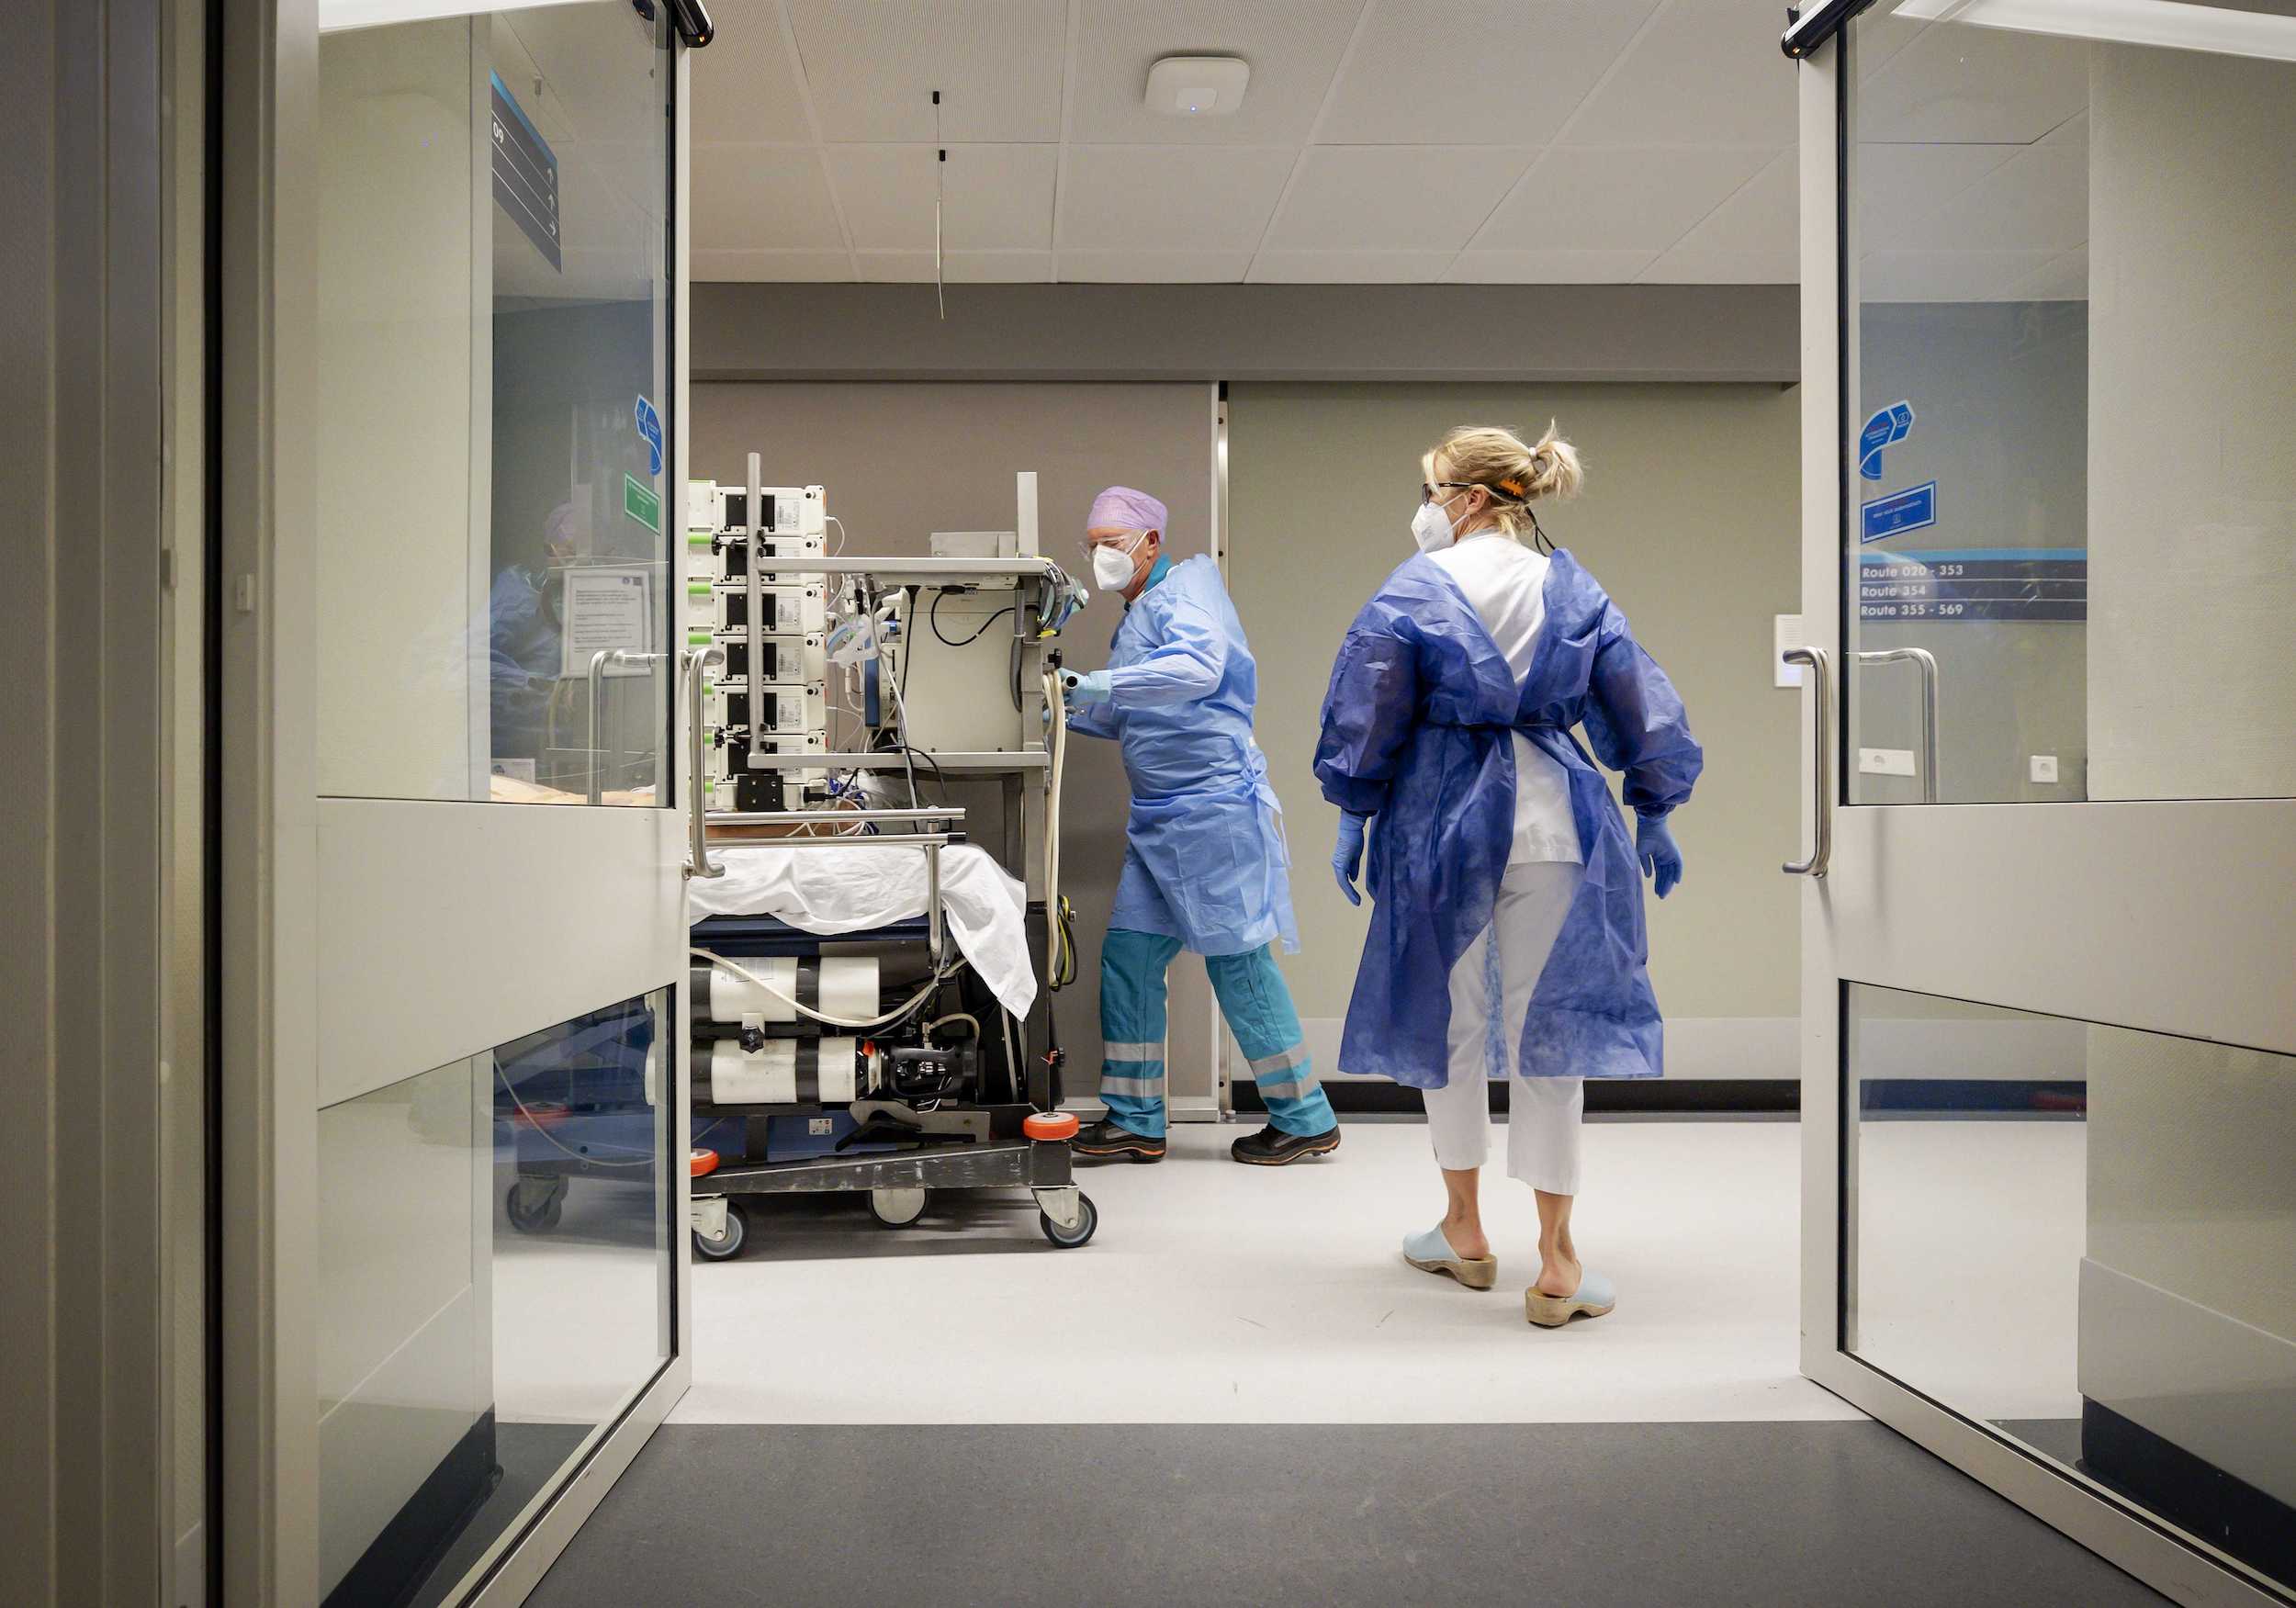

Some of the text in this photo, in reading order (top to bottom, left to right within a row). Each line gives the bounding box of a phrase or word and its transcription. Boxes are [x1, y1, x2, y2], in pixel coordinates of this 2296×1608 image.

[1863, 568, 1897, 578] Route
[1902, 566, 1927, 577] 020
[1939, 565, 1964, 576] 353
[1862, 585, 1926, 596] Route 354
[1861, 605, 1896, 615] Route
[1901, 604, 1926, 615] 355
[1939, 604, 1964, 615] 569
